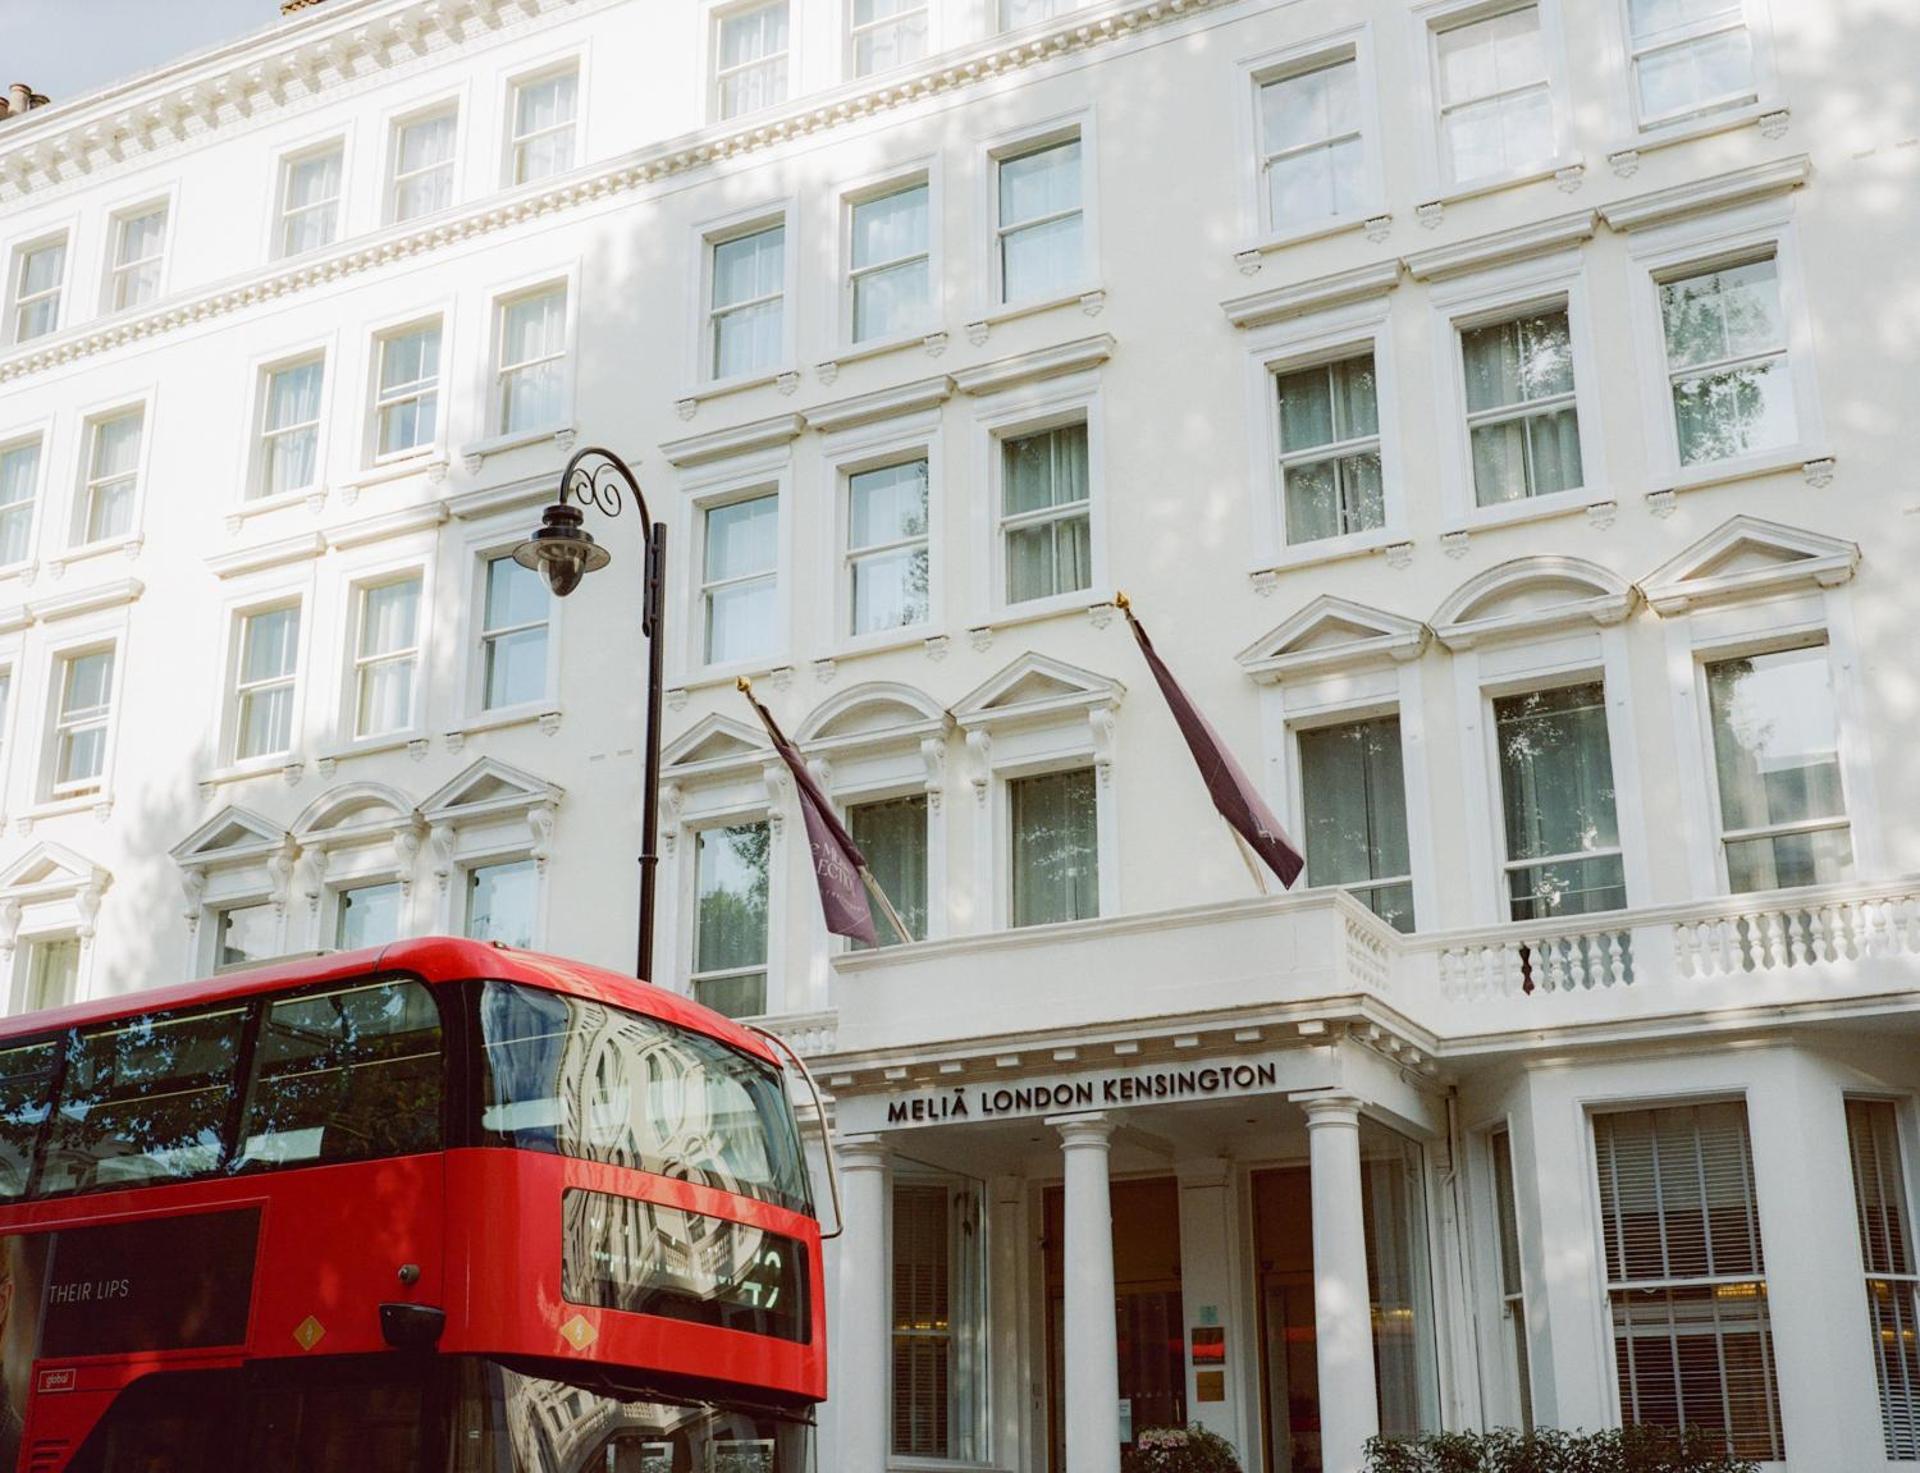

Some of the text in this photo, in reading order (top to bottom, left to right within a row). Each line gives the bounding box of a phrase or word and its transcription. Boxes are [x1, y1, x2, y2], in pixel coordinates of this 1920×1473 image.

[981, 1081, 1093, 1114] LONDON
[1103, 1062, 1277, 1100] KENSINGTON
[49, 1279, 130, 1304] THEIR LIPS
[45, 1373, 69, 1388] global
